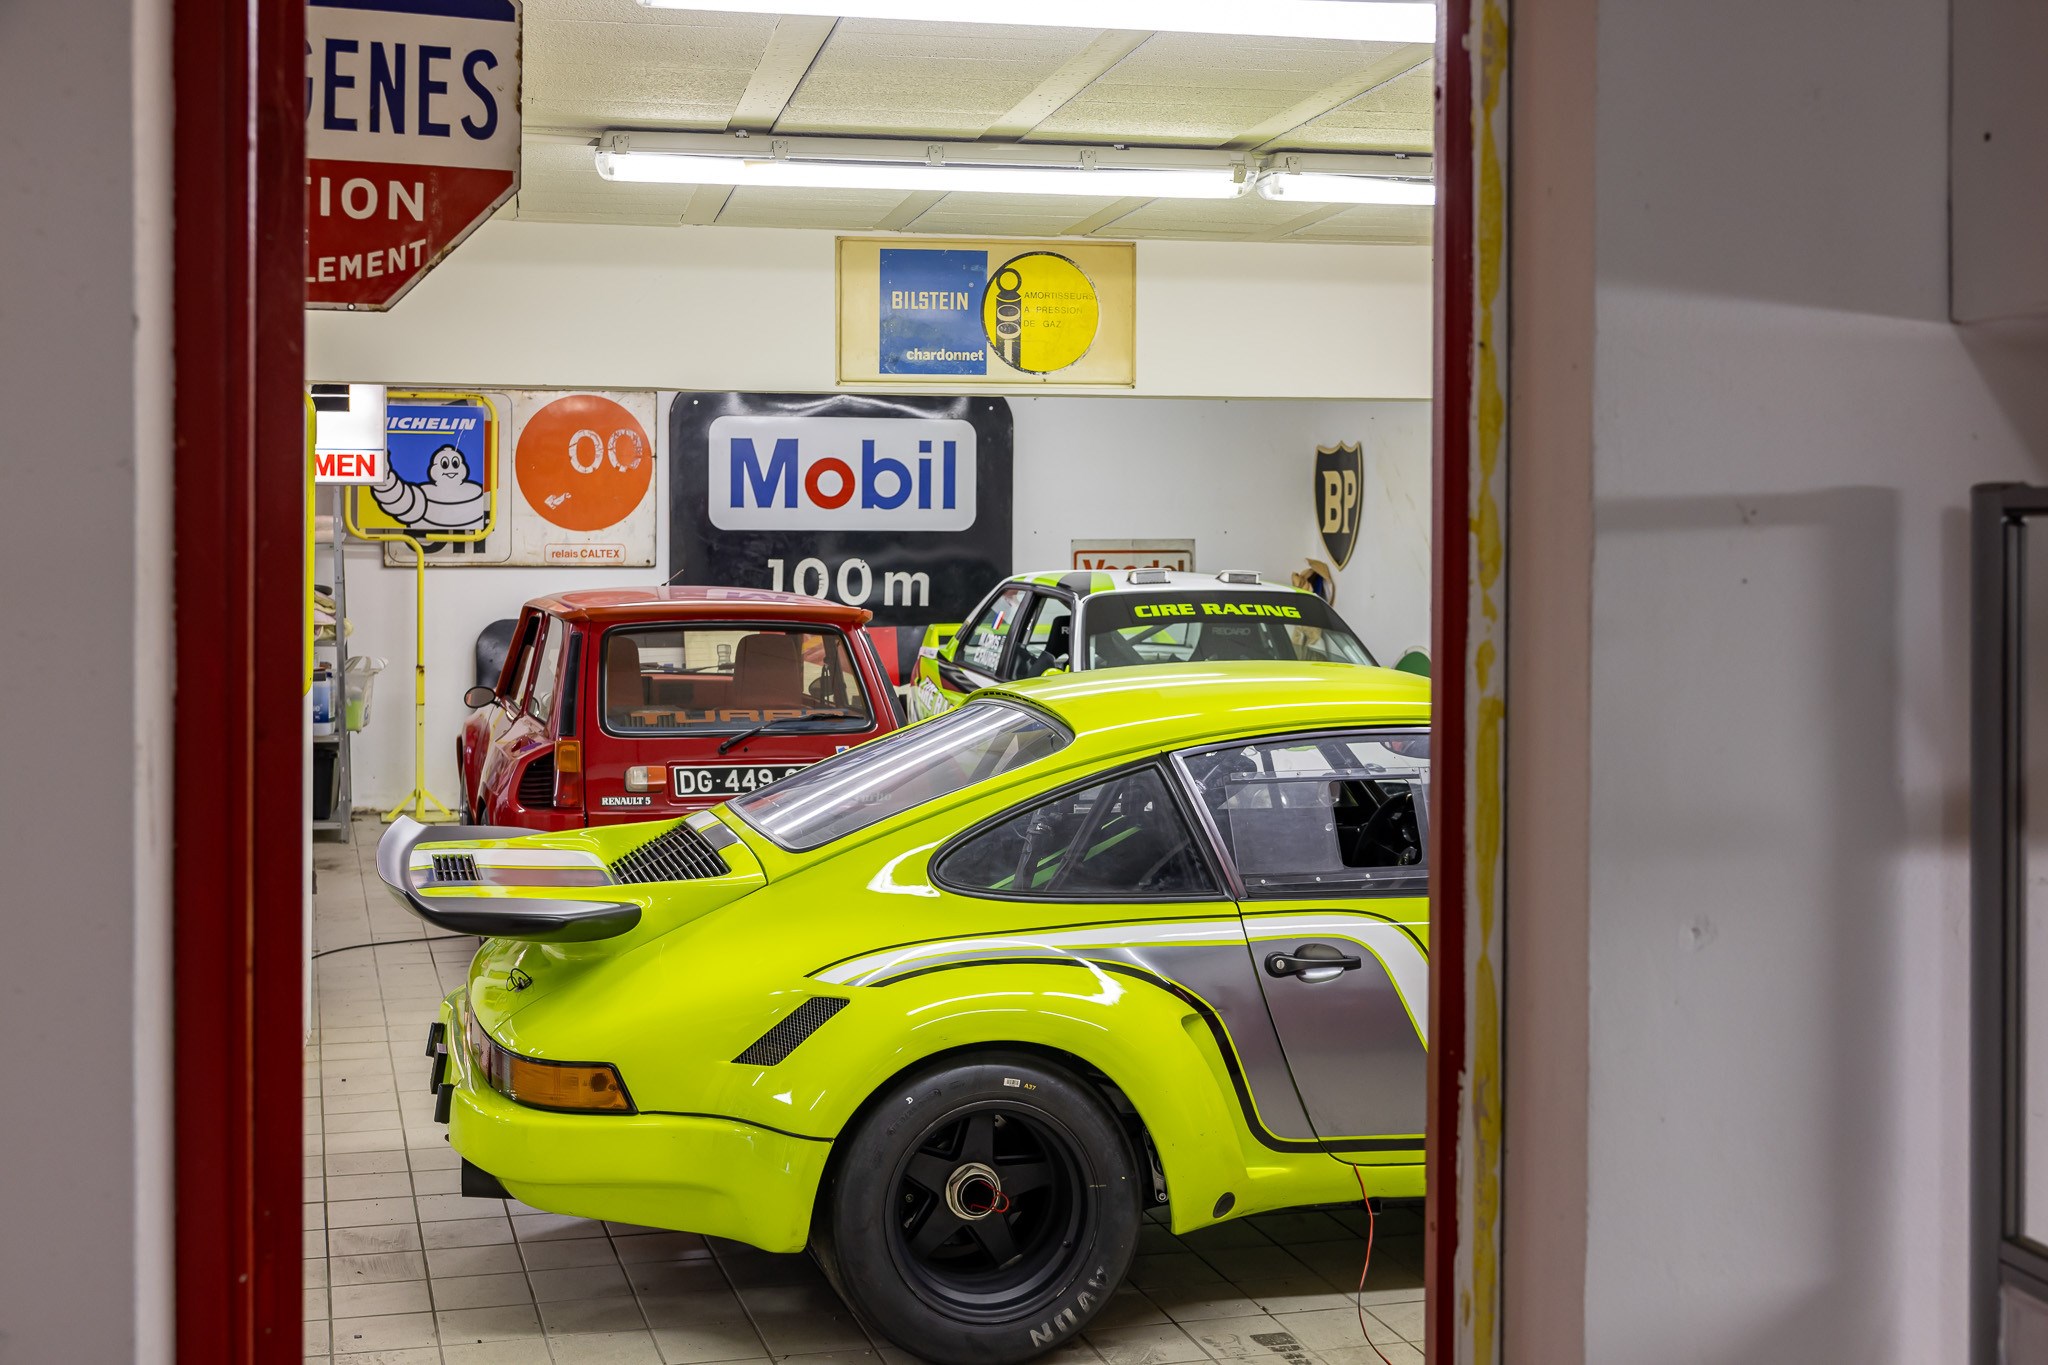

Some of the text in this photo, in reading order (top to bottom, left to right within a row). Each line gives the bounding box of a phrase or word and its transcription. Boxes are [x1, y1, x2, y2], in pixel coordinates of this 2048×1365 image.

[304, 37, 499, 141] ENES
[305, 177, 425, 222] ION
[891, 290, 969, 311] BILSTEIN
[1023, 291, 1095, 301] AMORTISSEURS
[1036, 306, 1084, 315] PRESSION
[1023, 320, 1062, 329] DE GAZ
[906, 347, 984, 362] chardonnet
[387, 416, 477, 431] ICHELIN
[730, 437, 957, 510] Mobil
[1321, 469, 1357, 534] BP
[551, 549, 620, 559] relais CALTEX
[767, 557, 930, 607] 100 m
[1133, 602, 1302, 619] CIRE RACING
[1211, 626, 1251, 636] RECARO
[601, 796, 652, 806] RENAULT 5
